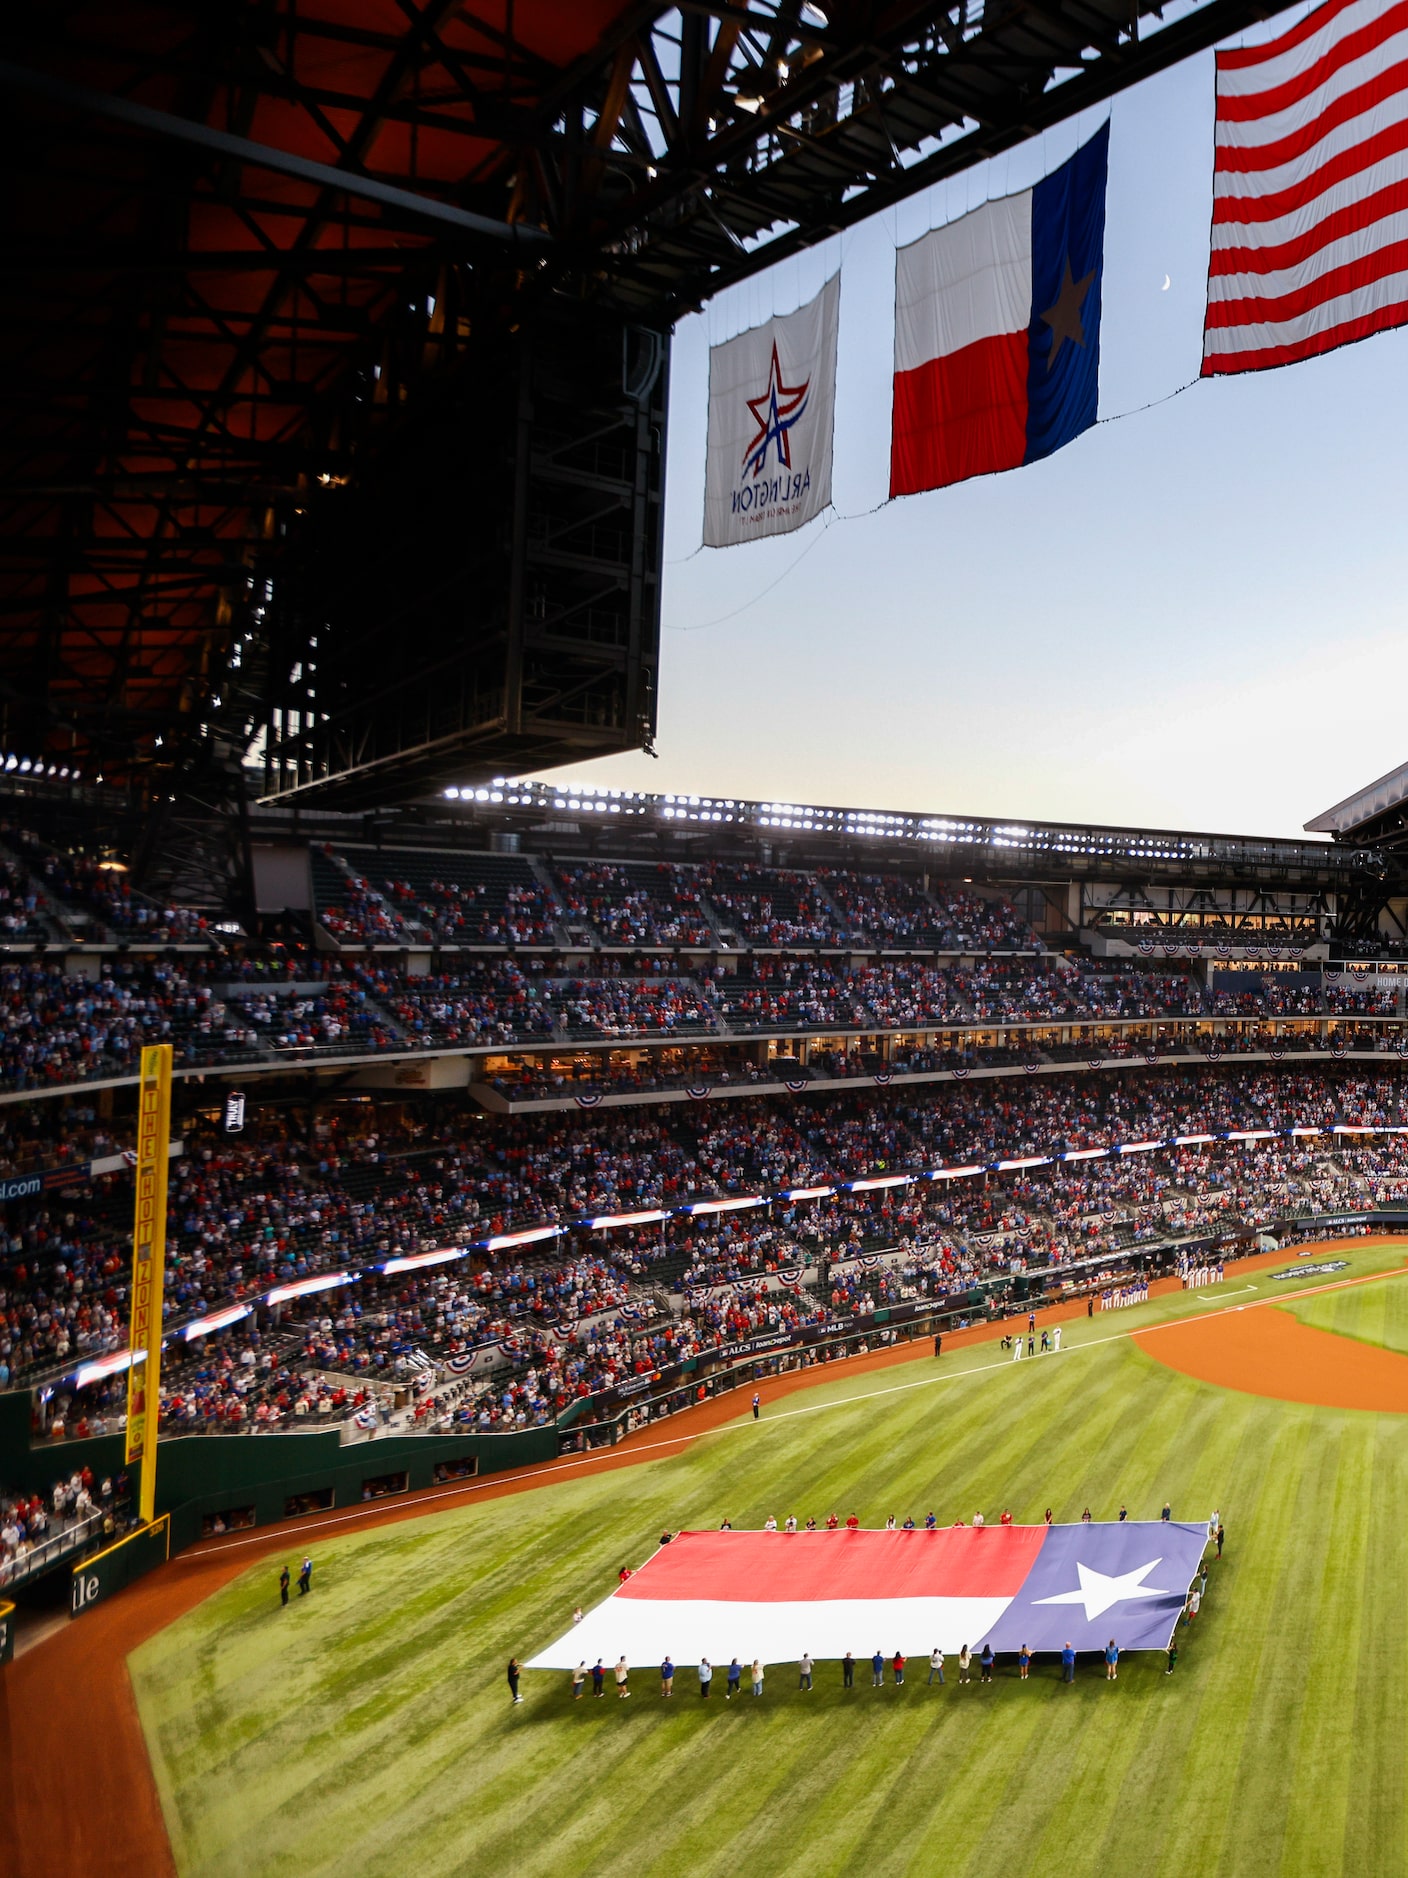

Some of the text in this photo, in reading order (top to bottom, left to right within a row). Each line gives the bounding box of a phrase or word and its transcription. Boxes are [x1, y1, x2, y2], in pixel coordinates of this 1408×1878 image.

[1377, 977, 1401, 988] HOME
[226, 1099, 239, 1127] TRULY
[135, 1092, 156, 1350] THE HOT ZONE
[826, 1322, 844, 1333] MLB
[728, 1334, 792, 1356] ALCS loanDepot
